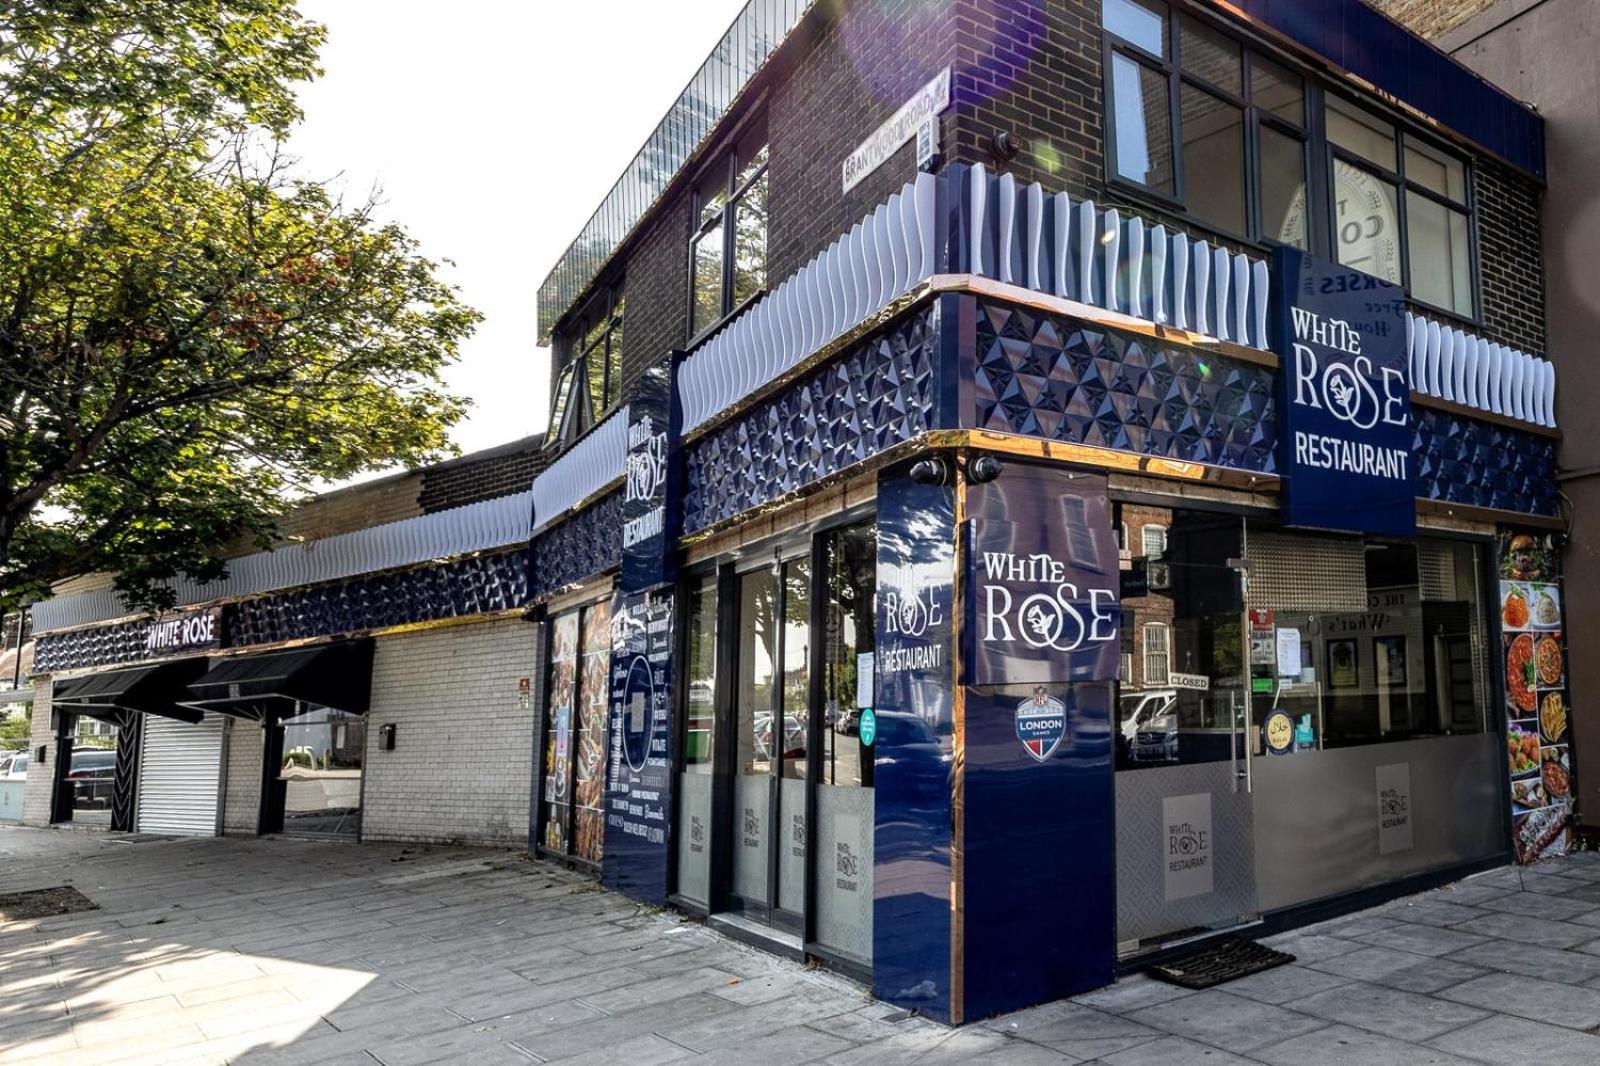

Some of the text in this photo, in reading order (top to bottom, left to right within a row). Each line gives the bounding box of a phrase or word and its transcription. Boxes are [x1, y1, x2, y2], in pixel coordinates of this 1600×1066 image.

[845, 120, 902, 182] BRANTWOOD
[1291, 306, 1361, 355] WHITE
[1292, 342, 1408, 430] ROSE
[629, 414, 653, 449] WHITE
[626, 432, 668, 502] ROSE
[1295, 431, 1408, 480] RESTAURANT
[623, 506, 665, 549] RESTAURANT
[983, 552, 1065, 583] WHITE
[885, 583, 943, 637] ROSE
[983, 583, 1117, 652] ROSE
[147, 615, 214, 649] WHITE ROSE
[885, 644, 941, 673] RESTAURANT
[1171, 676, 1208, 689] CLOSED
[1020, 719, 1062, 731] LONDON
[1169, 831, 1208, 855] ROSE
[1169, 856, 1208, 872] RESTAURANT
